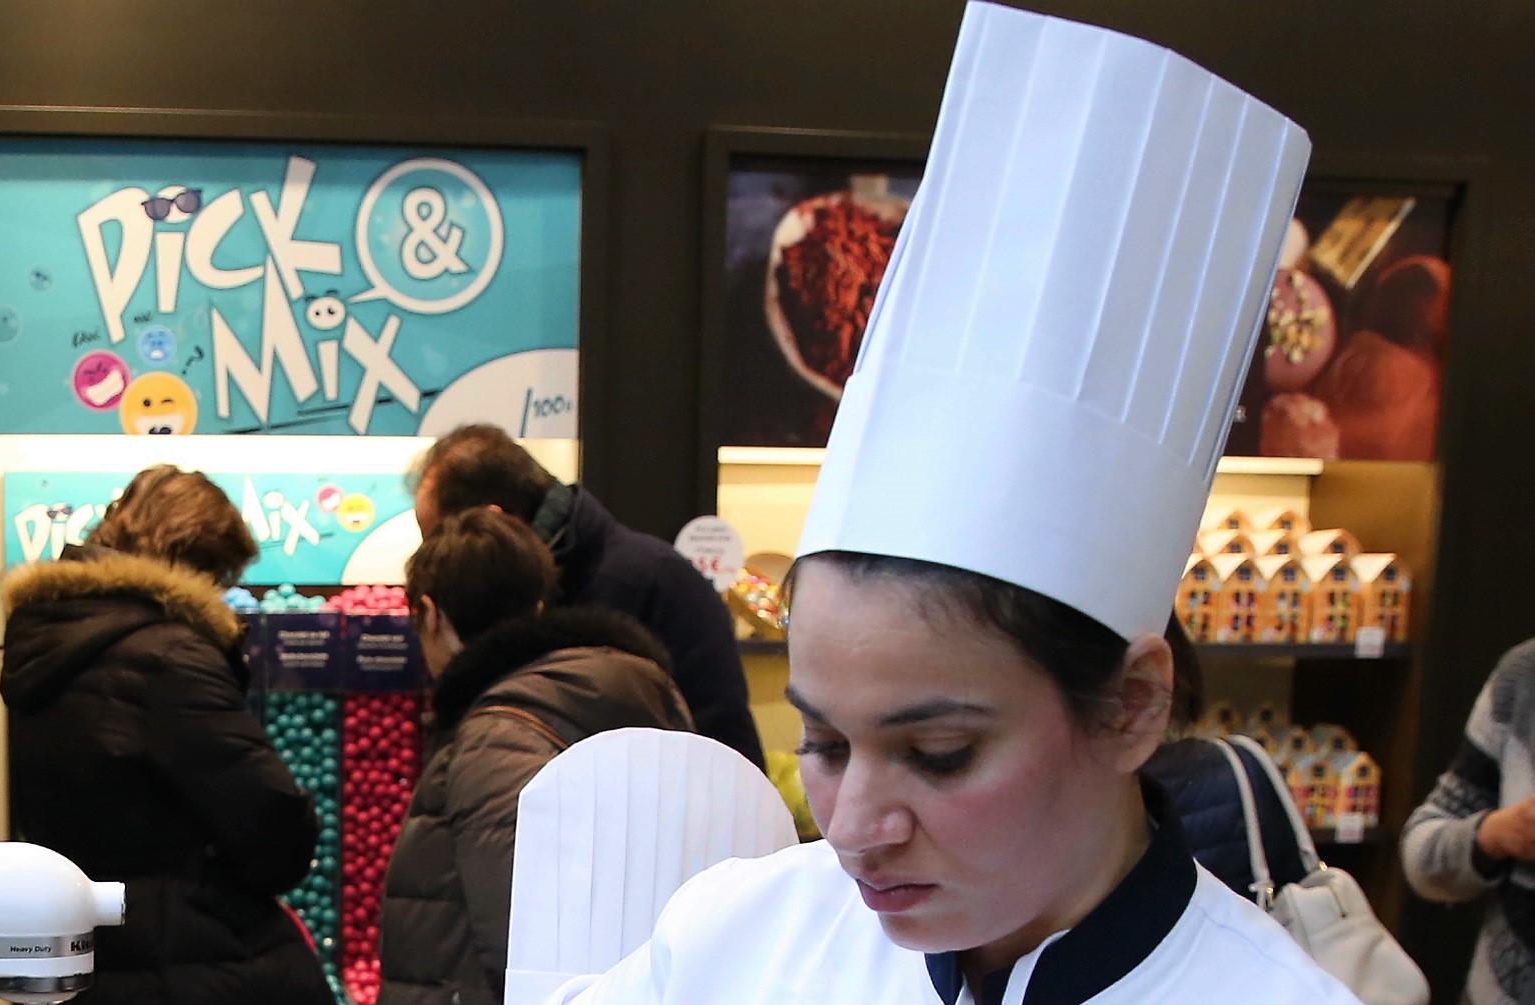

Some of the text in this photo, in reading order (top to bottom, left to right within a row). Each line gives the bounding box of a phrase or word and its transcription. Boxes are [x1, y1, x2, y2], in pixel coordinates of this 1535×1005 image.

[398, 186, 470, 281] &
[10, 945, 33, 954] Heavy
[34, 945, 52, 953] Duty
